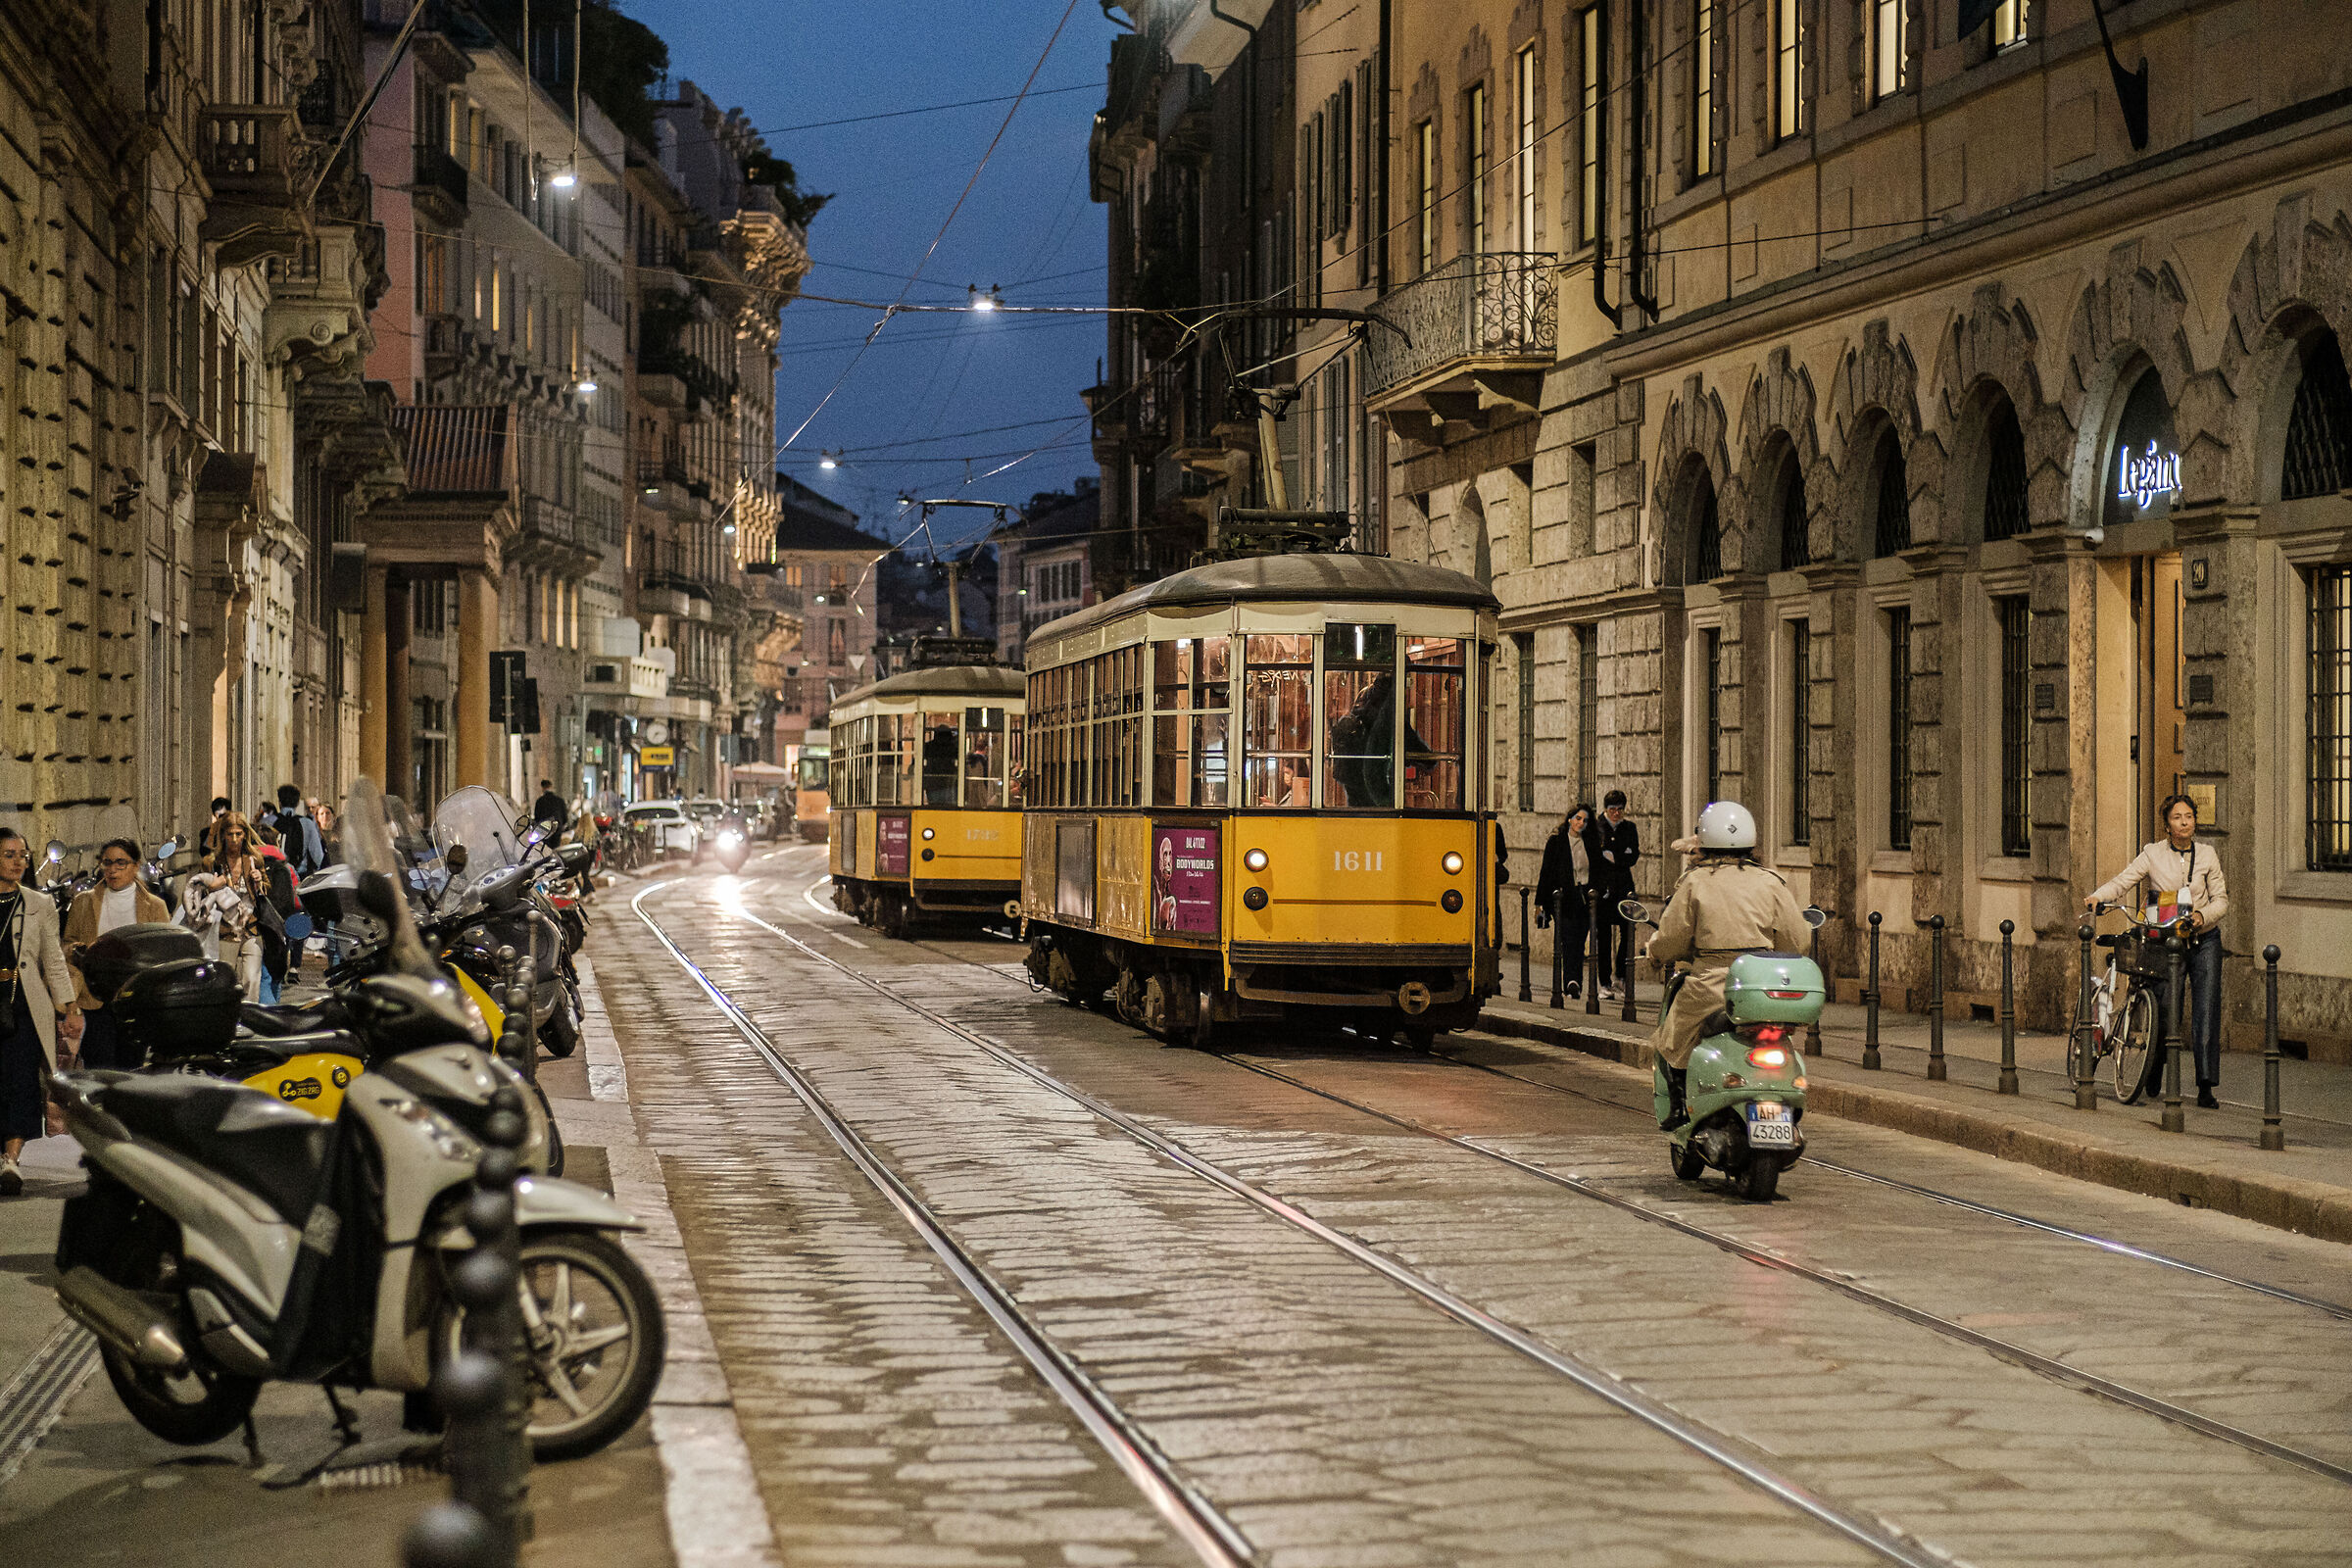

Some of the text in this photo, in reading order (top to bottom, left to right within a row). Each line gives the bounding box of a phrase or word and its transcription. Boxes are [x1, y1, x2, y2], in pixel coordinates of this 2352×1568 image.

[1176, 858, 1214, 870] BODYWORLDS
[1335, 852, 1383, 871] 1611
[1760, 1105, 1775, 1120] AH
[1753, 1125, 1791, 1140] 43288
